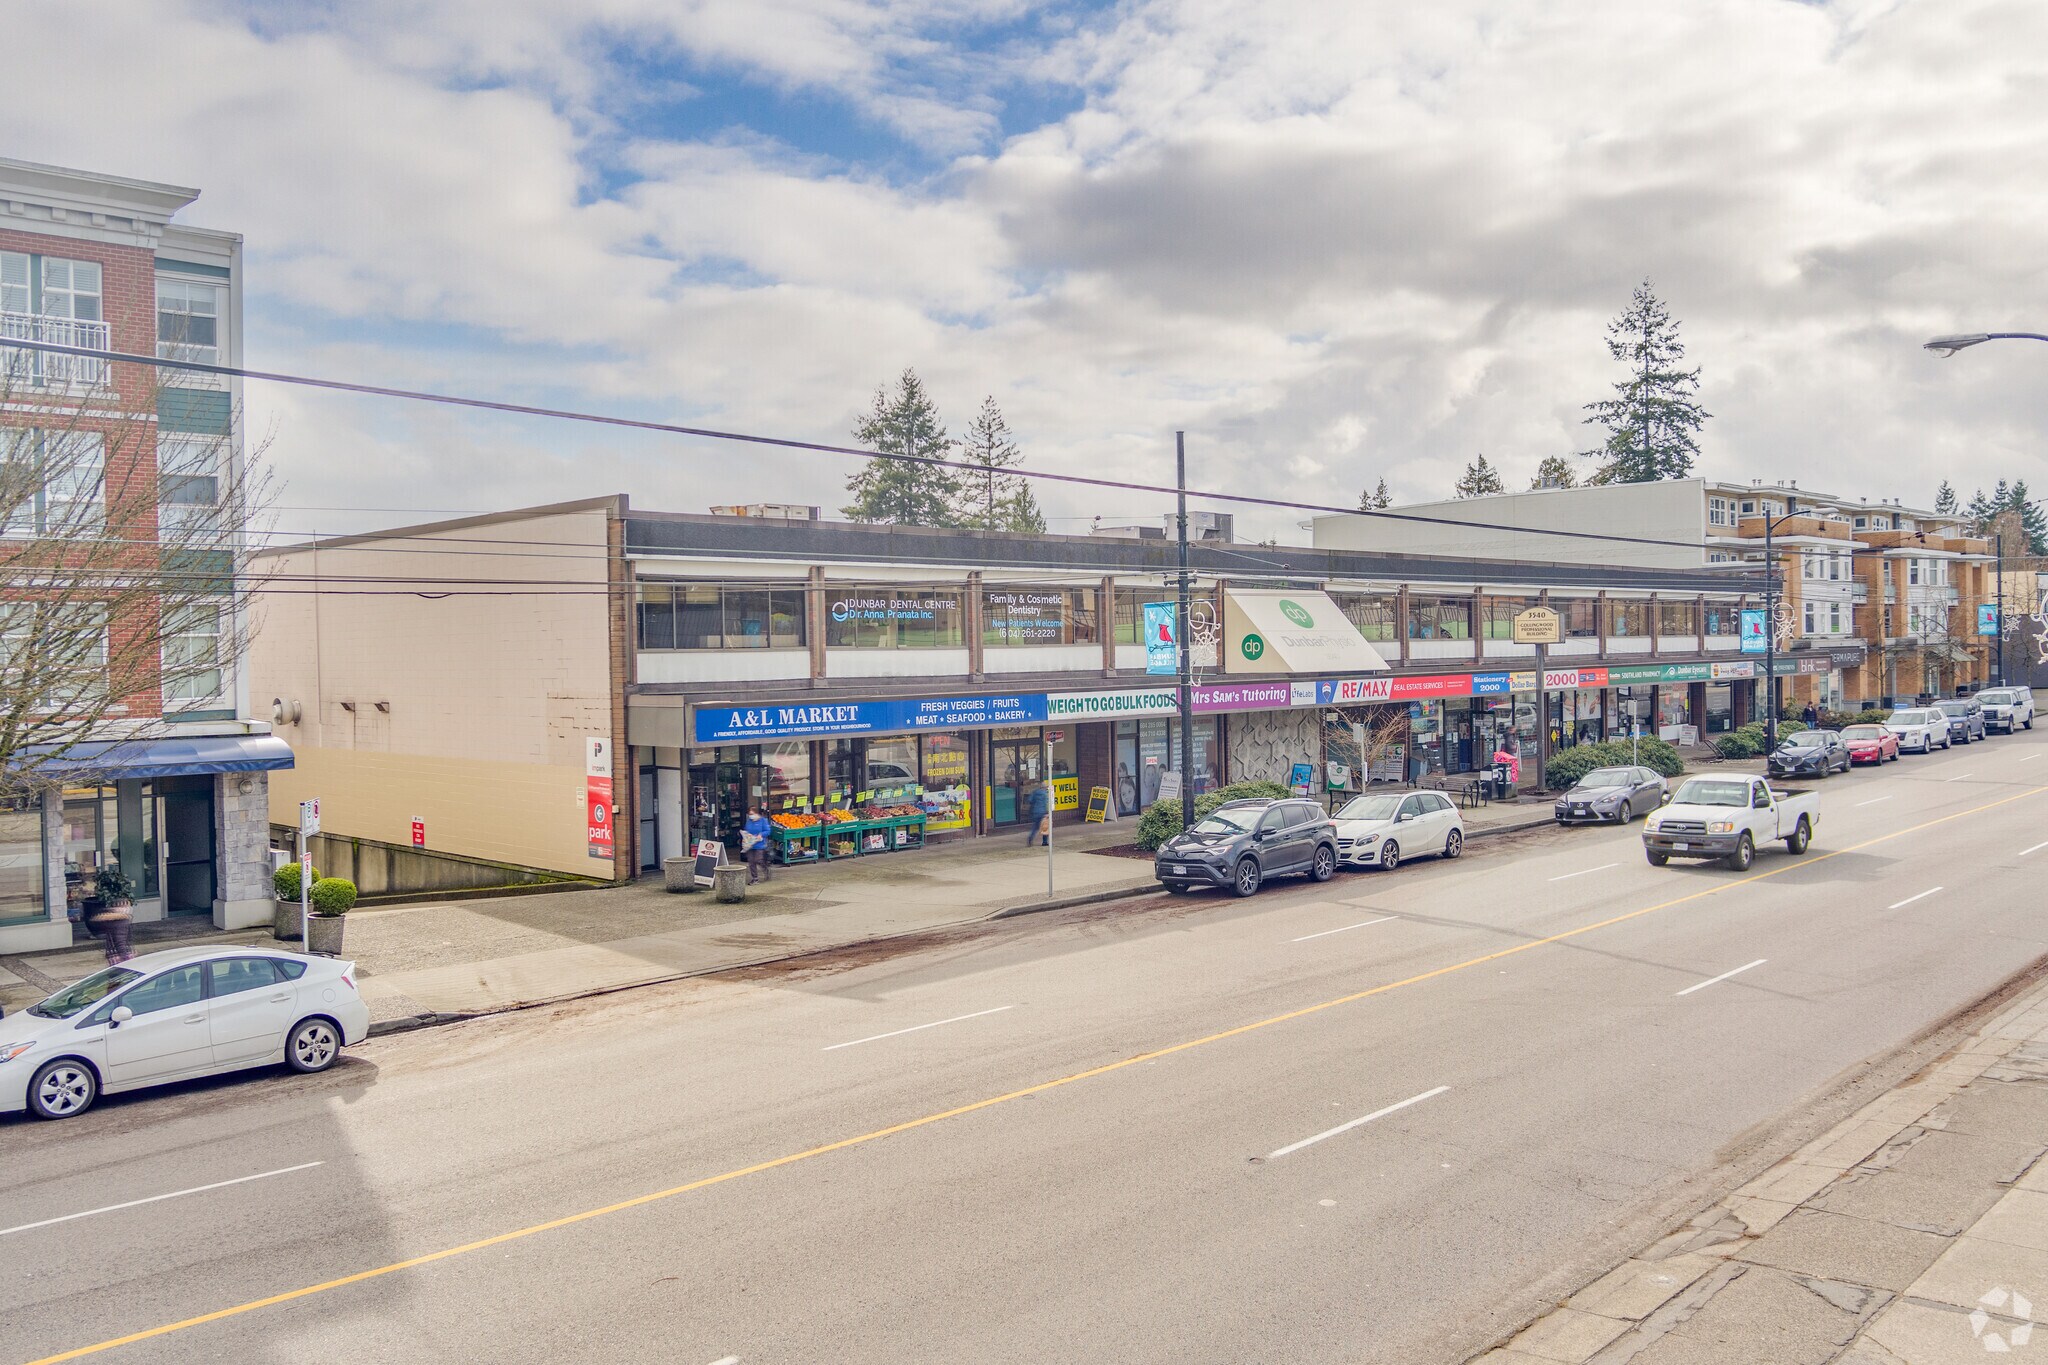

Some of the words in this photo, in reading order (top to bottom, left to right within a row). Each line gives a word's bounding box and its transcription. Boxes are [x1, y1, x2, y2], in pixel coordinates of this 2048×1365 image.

[849, 599, 886, 608] DUNBAR
[891, 600, 922, 609] DENTAL
[924, 600, 956, 609] CENTRE
[990, 594, 1017, 605] Family
[1019, 595, 1025, 604] &
[1027, 595, 1062, 604] Cosmetic
[849, 610, 862, 618] Dr.
[864, 610, 884, 618] Anna
[887, 610, 919, 619] Pranata
[1008, 606, 1041, 616] Dentistry
[992, 619, 1006, 627] New
[1009, 619, 1034, 627] Patients
[1035, 619, 1063, 627] Welcome
[999, 628, 1020, 638] (604)
[1021, 628, 1056, 638] 261-2220
[1244, 638, 1261, 655] dp
[1546, 673, 1577, 686] 2000
[1191, 691, 1210, 704] Mrs
[1242, 686, 1286, 702] Tutoring
[1342, 681, 1387, 698] RE/MAX
[921, 702, 948, 712] FRESH
[950, 700, 985, 710] VEGGIES
[992, 699, 1019, 708] FRUITS
[729, 710, 773, 727] A&L
[778, 705, 858, 725] MARKET
[915, 715, 938, 725] MEAT
[946, 713, 986, 723] SEAFOOD
[995, 710, 1026, 720] BAKERY
[1059, 783, 1077, 791] WELL
[1060, 795, 1077, 804] LESS
[589, 824, 611, 841] park
